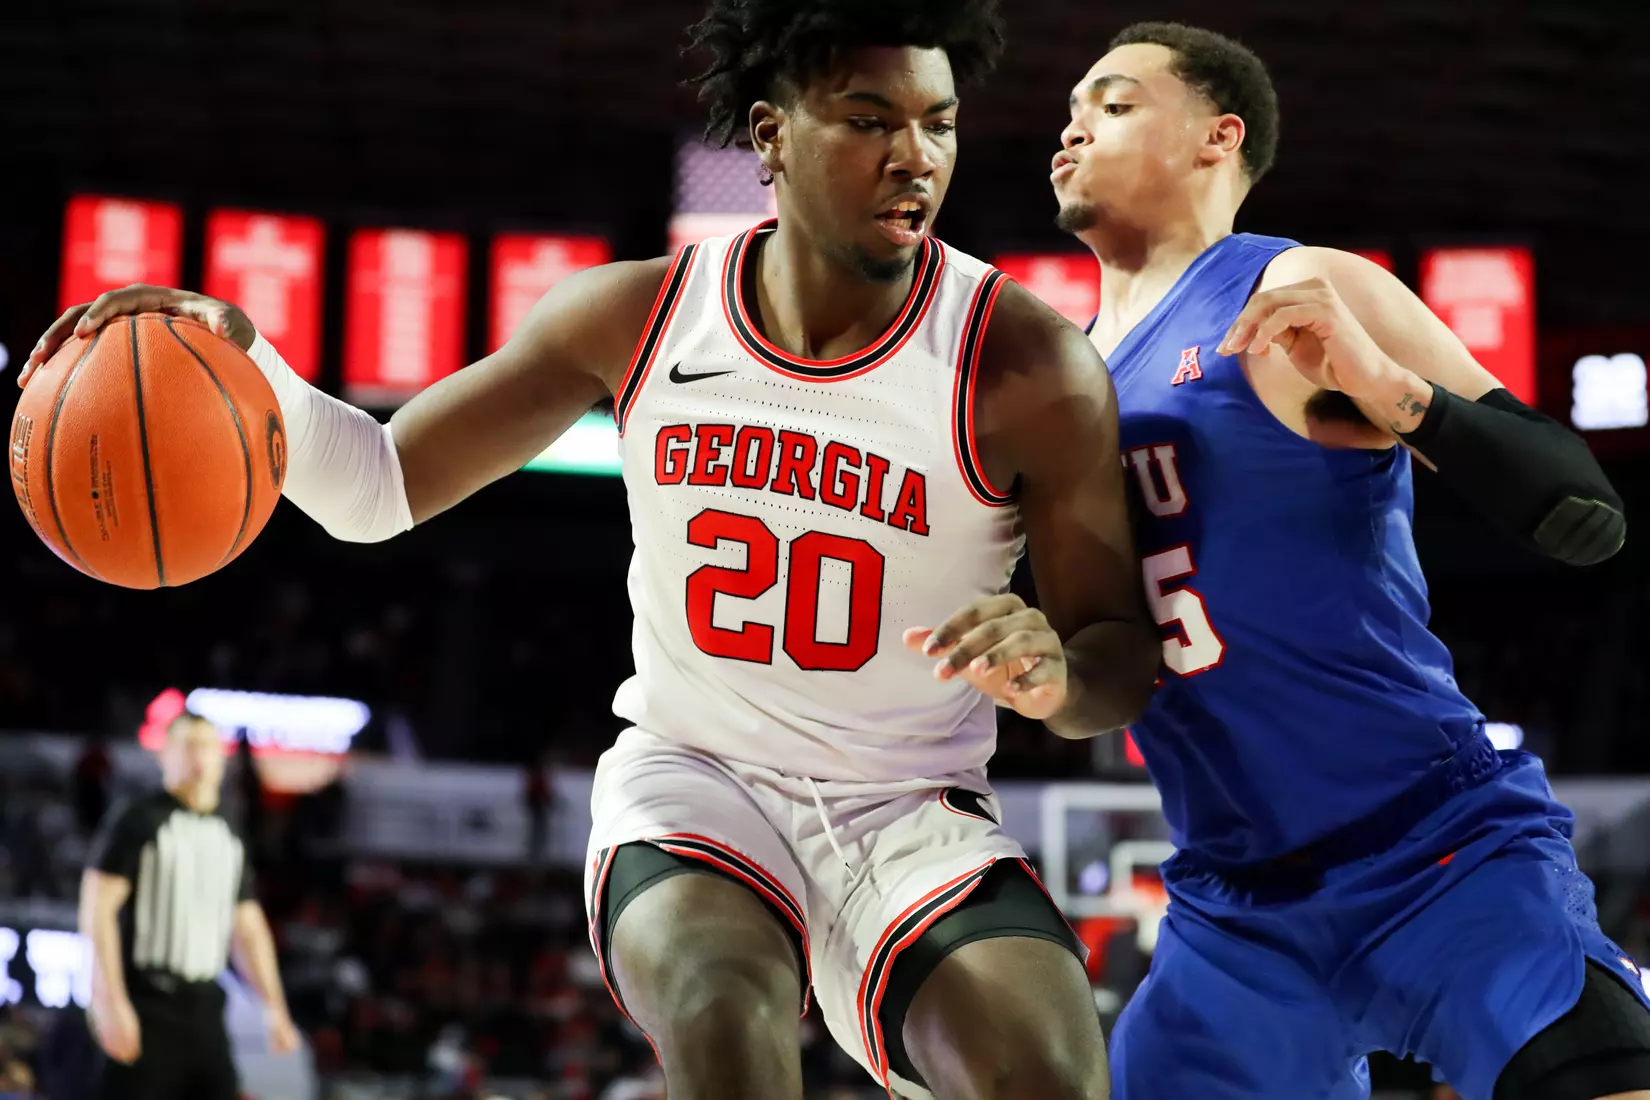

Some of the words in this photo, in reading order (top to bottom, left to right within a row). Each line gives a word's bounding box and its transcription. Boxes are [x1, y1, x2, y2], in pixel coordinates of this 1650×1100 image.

[1170, 345, 1203, 386] A
[654, 423, 931, 537] GEORGIA
[1120, 442, 1189, 518] U
[685, 507, 886, 673] 20
[1141, 541, 1227, 688] 5
